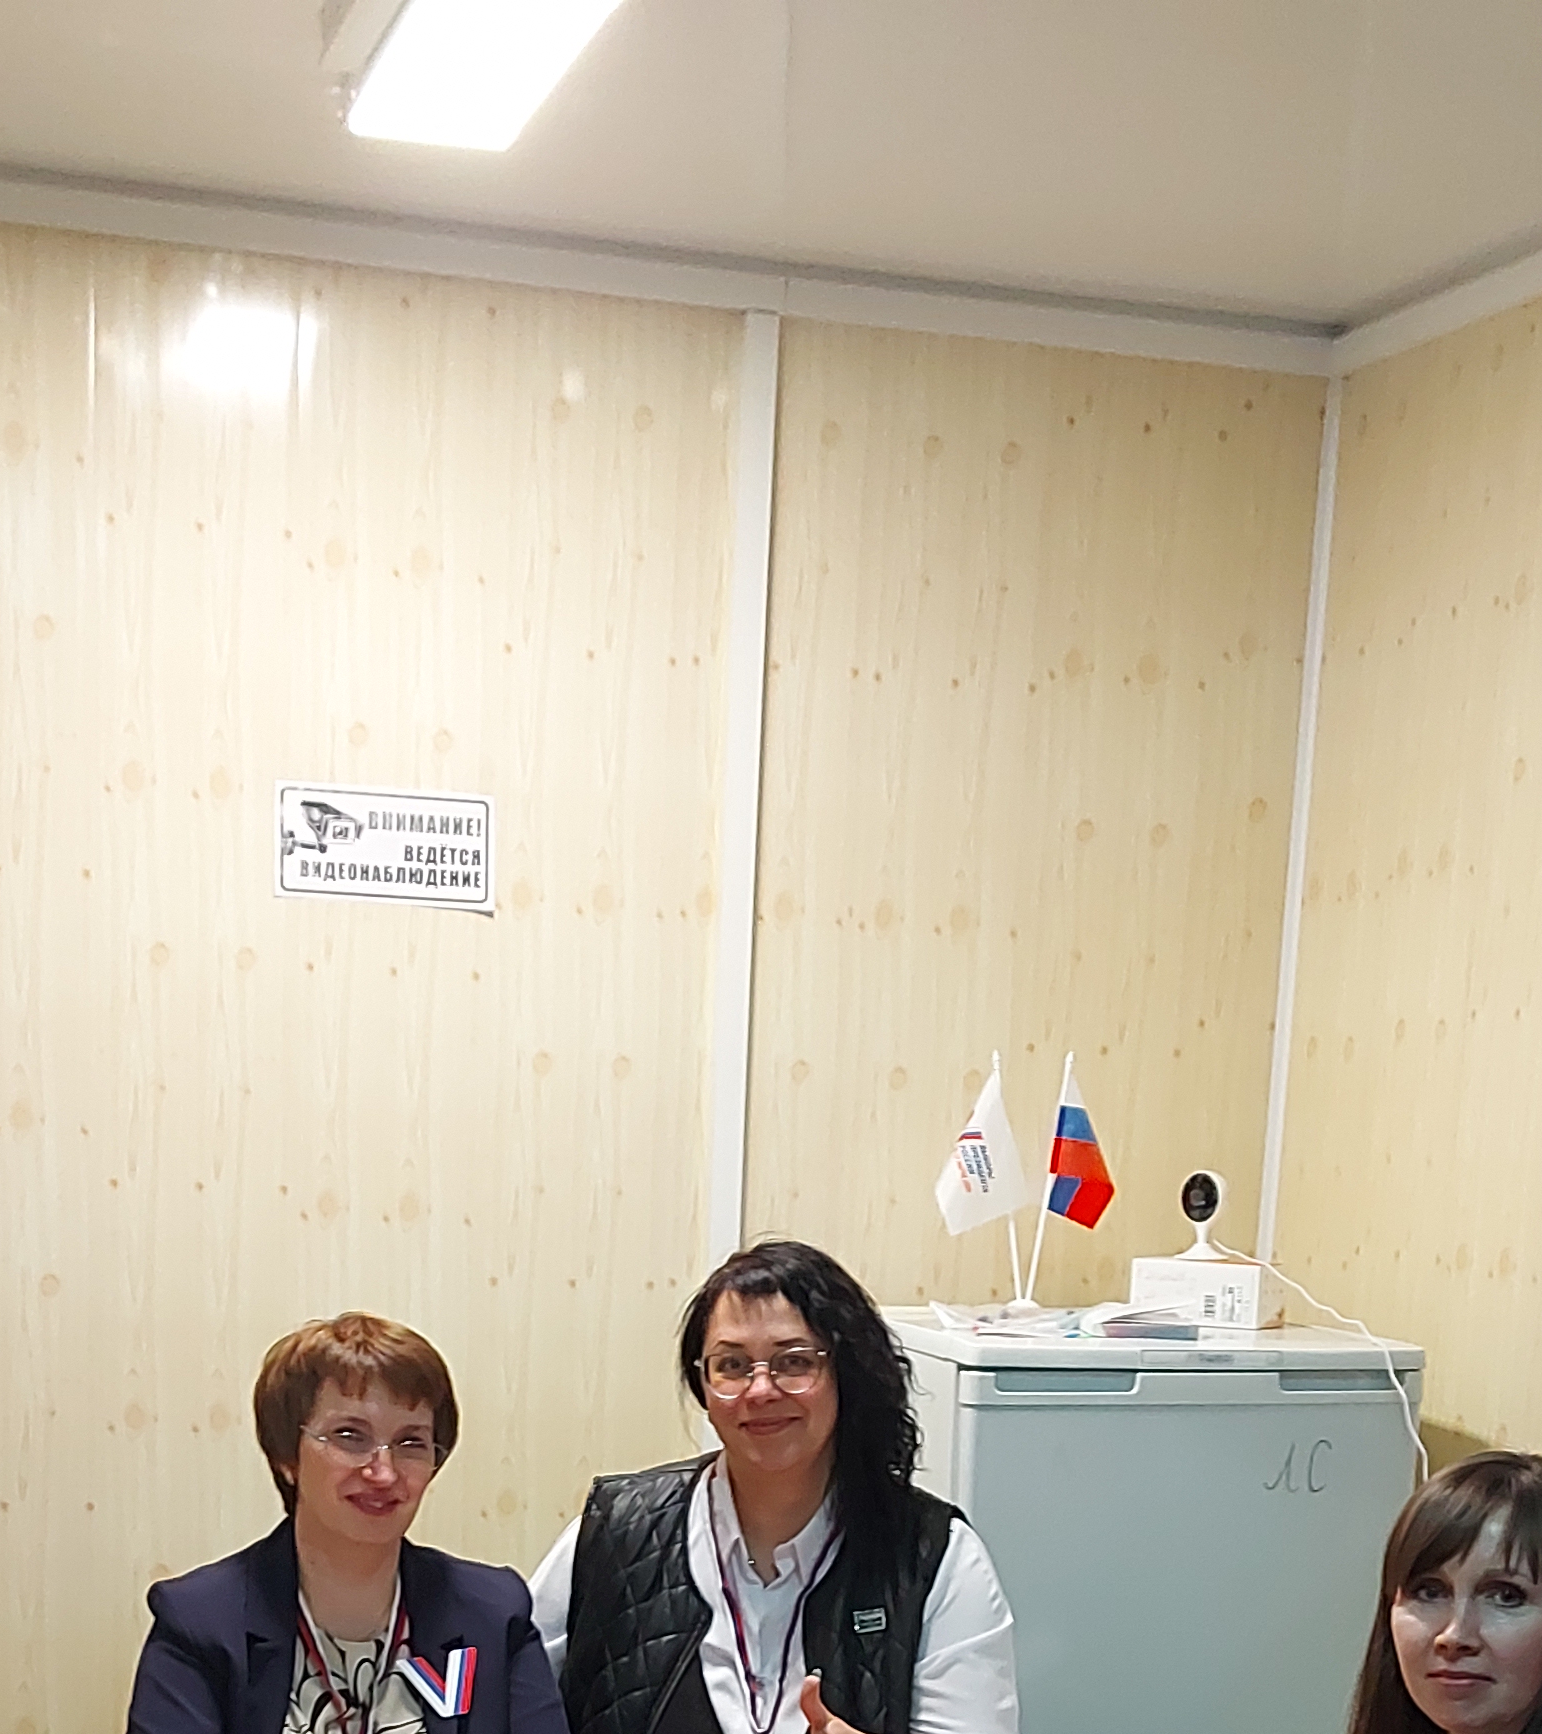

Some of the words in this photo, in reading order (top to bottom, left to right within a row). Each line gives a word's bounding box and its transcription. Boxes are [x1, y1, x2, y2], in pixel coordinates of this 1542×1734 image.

[368, 811, 482, 837] ВНИМАНИЕ!
[404, 844, 481, 866] ВЕДЁТСЯ
[300, 860, 481, 888] ВИДЕОНАБЛЮДЕНИЕ
